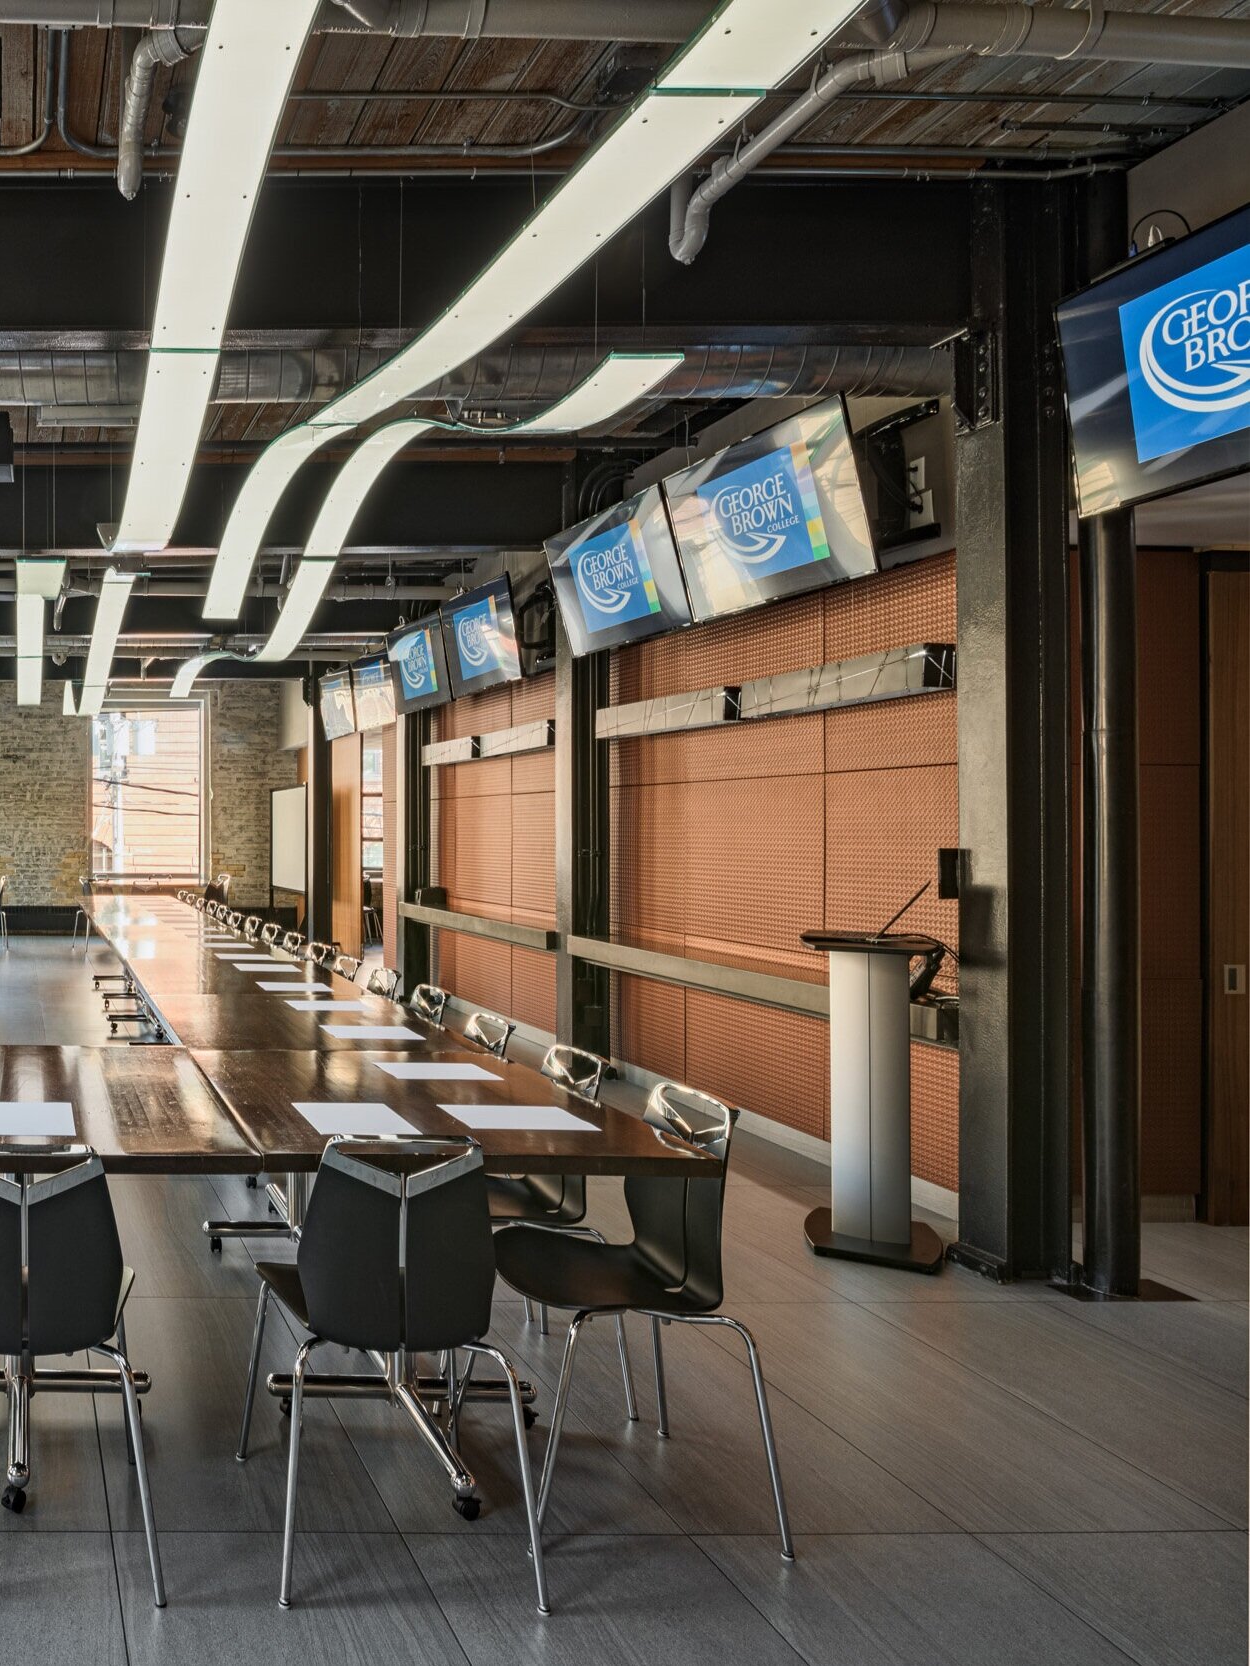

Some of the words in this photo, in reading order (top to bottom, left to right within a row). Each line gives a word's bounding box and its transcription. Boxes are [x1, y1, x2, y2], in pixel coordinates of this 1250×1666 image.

[719, 473, 786, 518] GEORGE
[731, 493, 793, 536] BROWN
[767, 515, 800, 533] COLLEGE
[584, 543, 628, 576] GEORGE
[592, 559, 634, 591] BROWN
